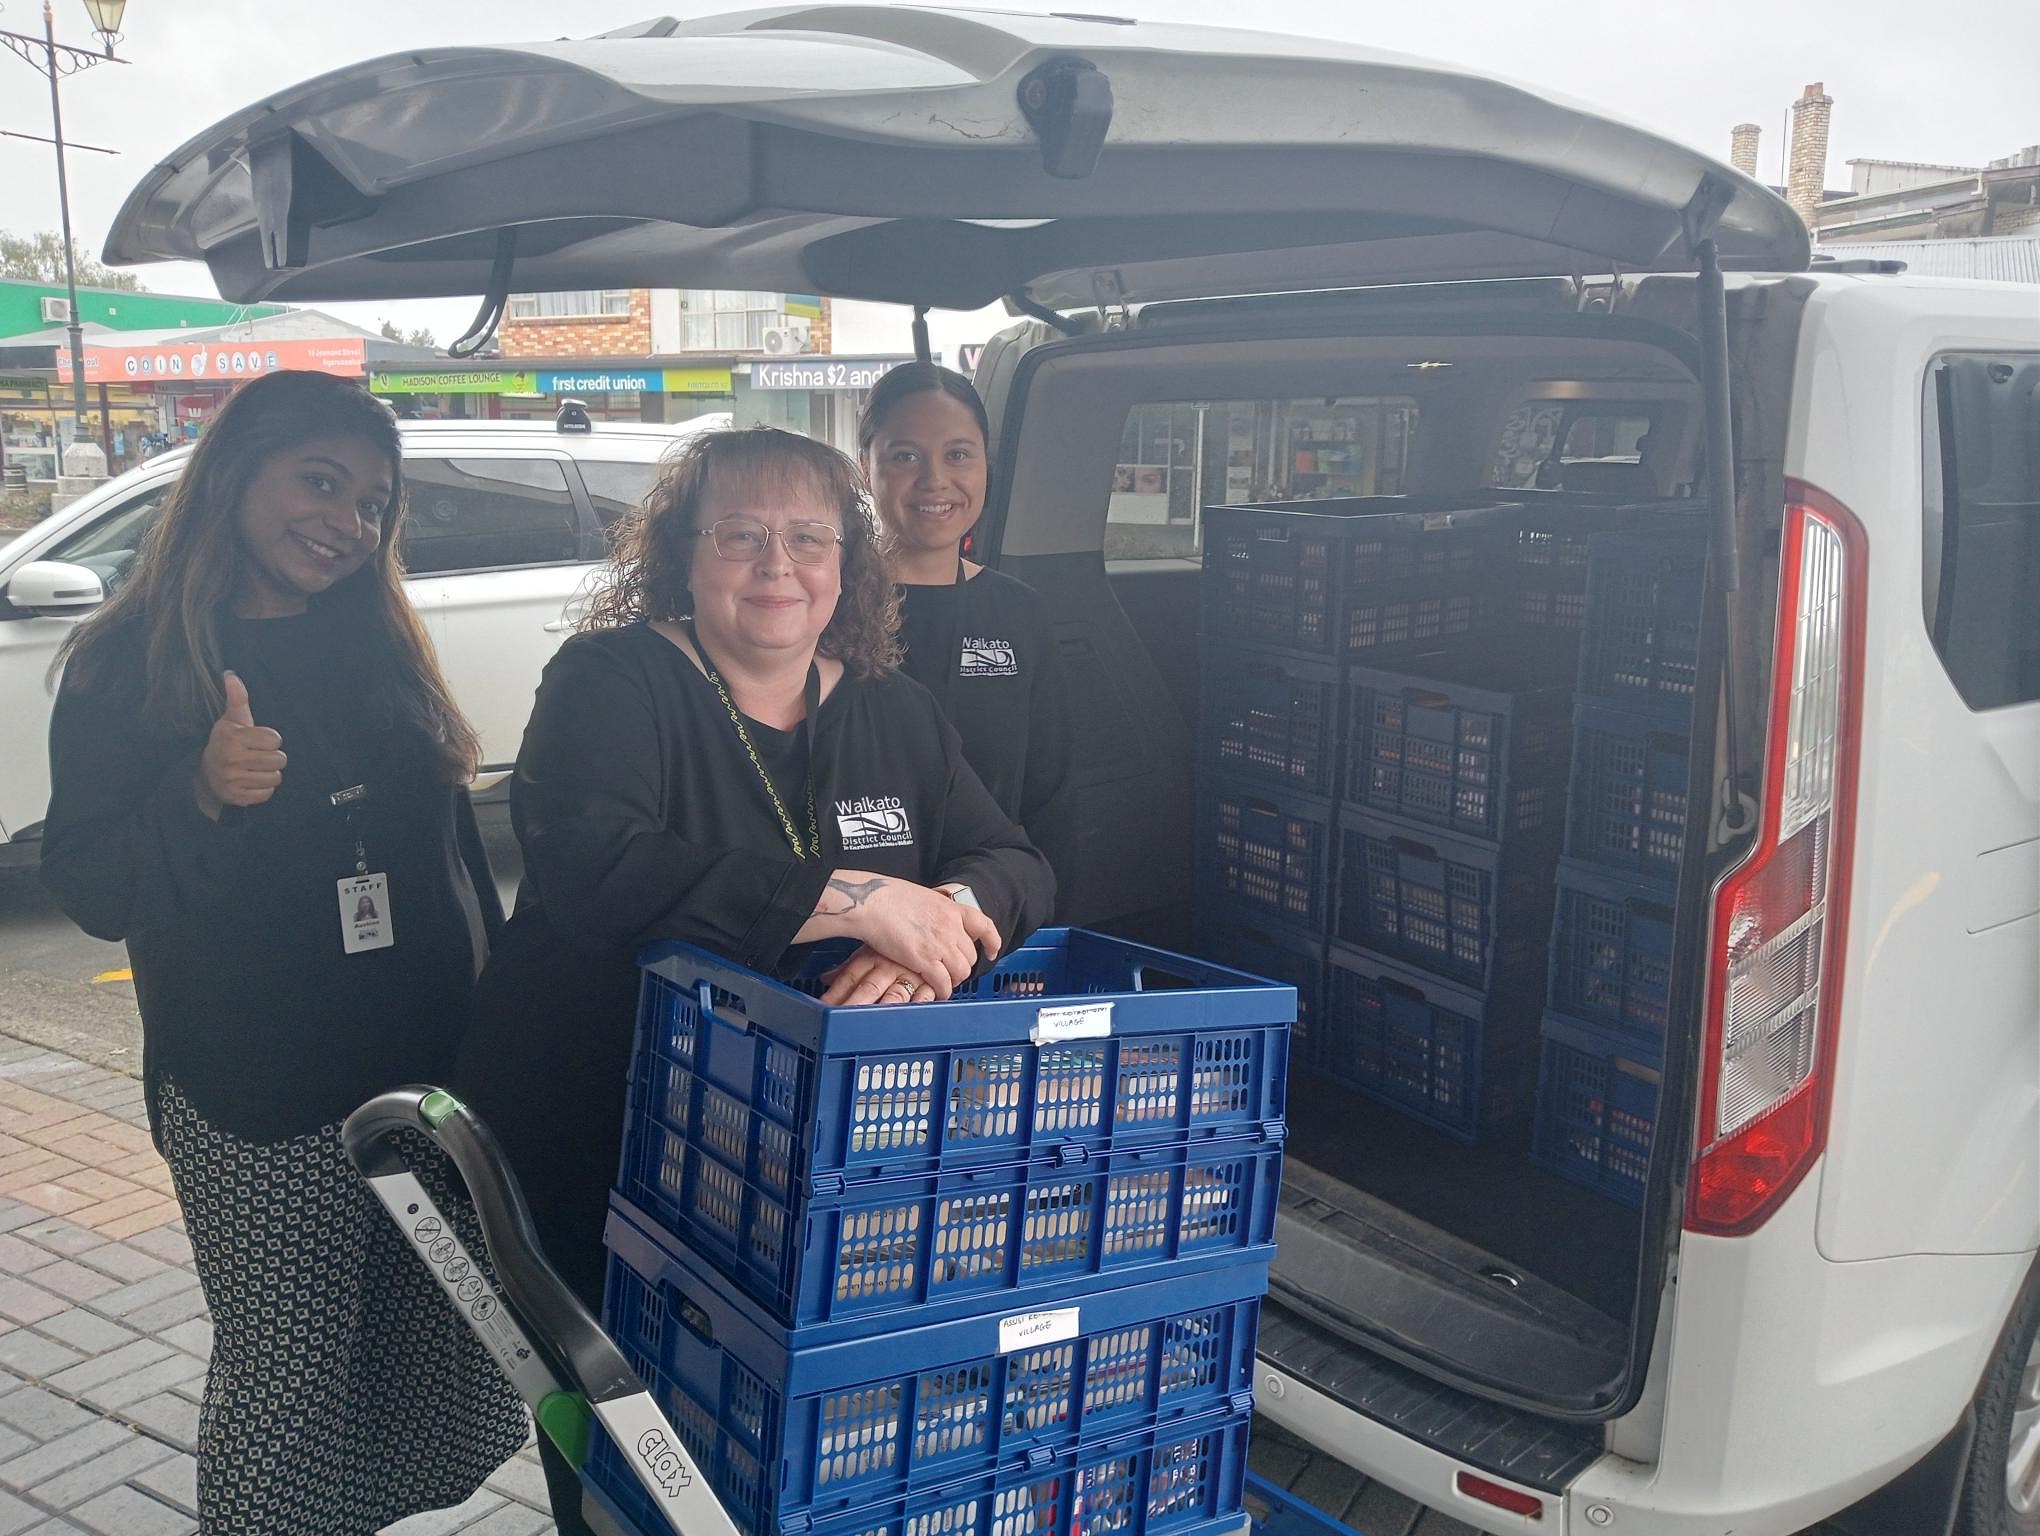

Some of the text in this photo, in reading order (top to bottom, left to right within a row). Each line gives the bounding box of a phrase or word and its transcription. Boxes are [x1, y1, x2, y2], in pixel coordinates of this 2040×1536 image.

[127, 354, 276, 375] COIN SAVE
[438, 374, 466, 385] COFFEE
[469, 372, 500, 383] LOUNGE
[552, 375, 646, 391] first credit union
[759, 365, 824, 387] Krishna
[827, 364, 846, 387] $2
[850, 364, 883, 386] and
[835, 796, 900, 815] Waikato
[842, 835, 878, 846] District
[880, 831, 913, 842] Council
[344, 882, 382, 895] STAFF
[1053, 1017, 1085, 1028] VILLAGE
[1019, 1320, 1053, 1337] VILLAGE
